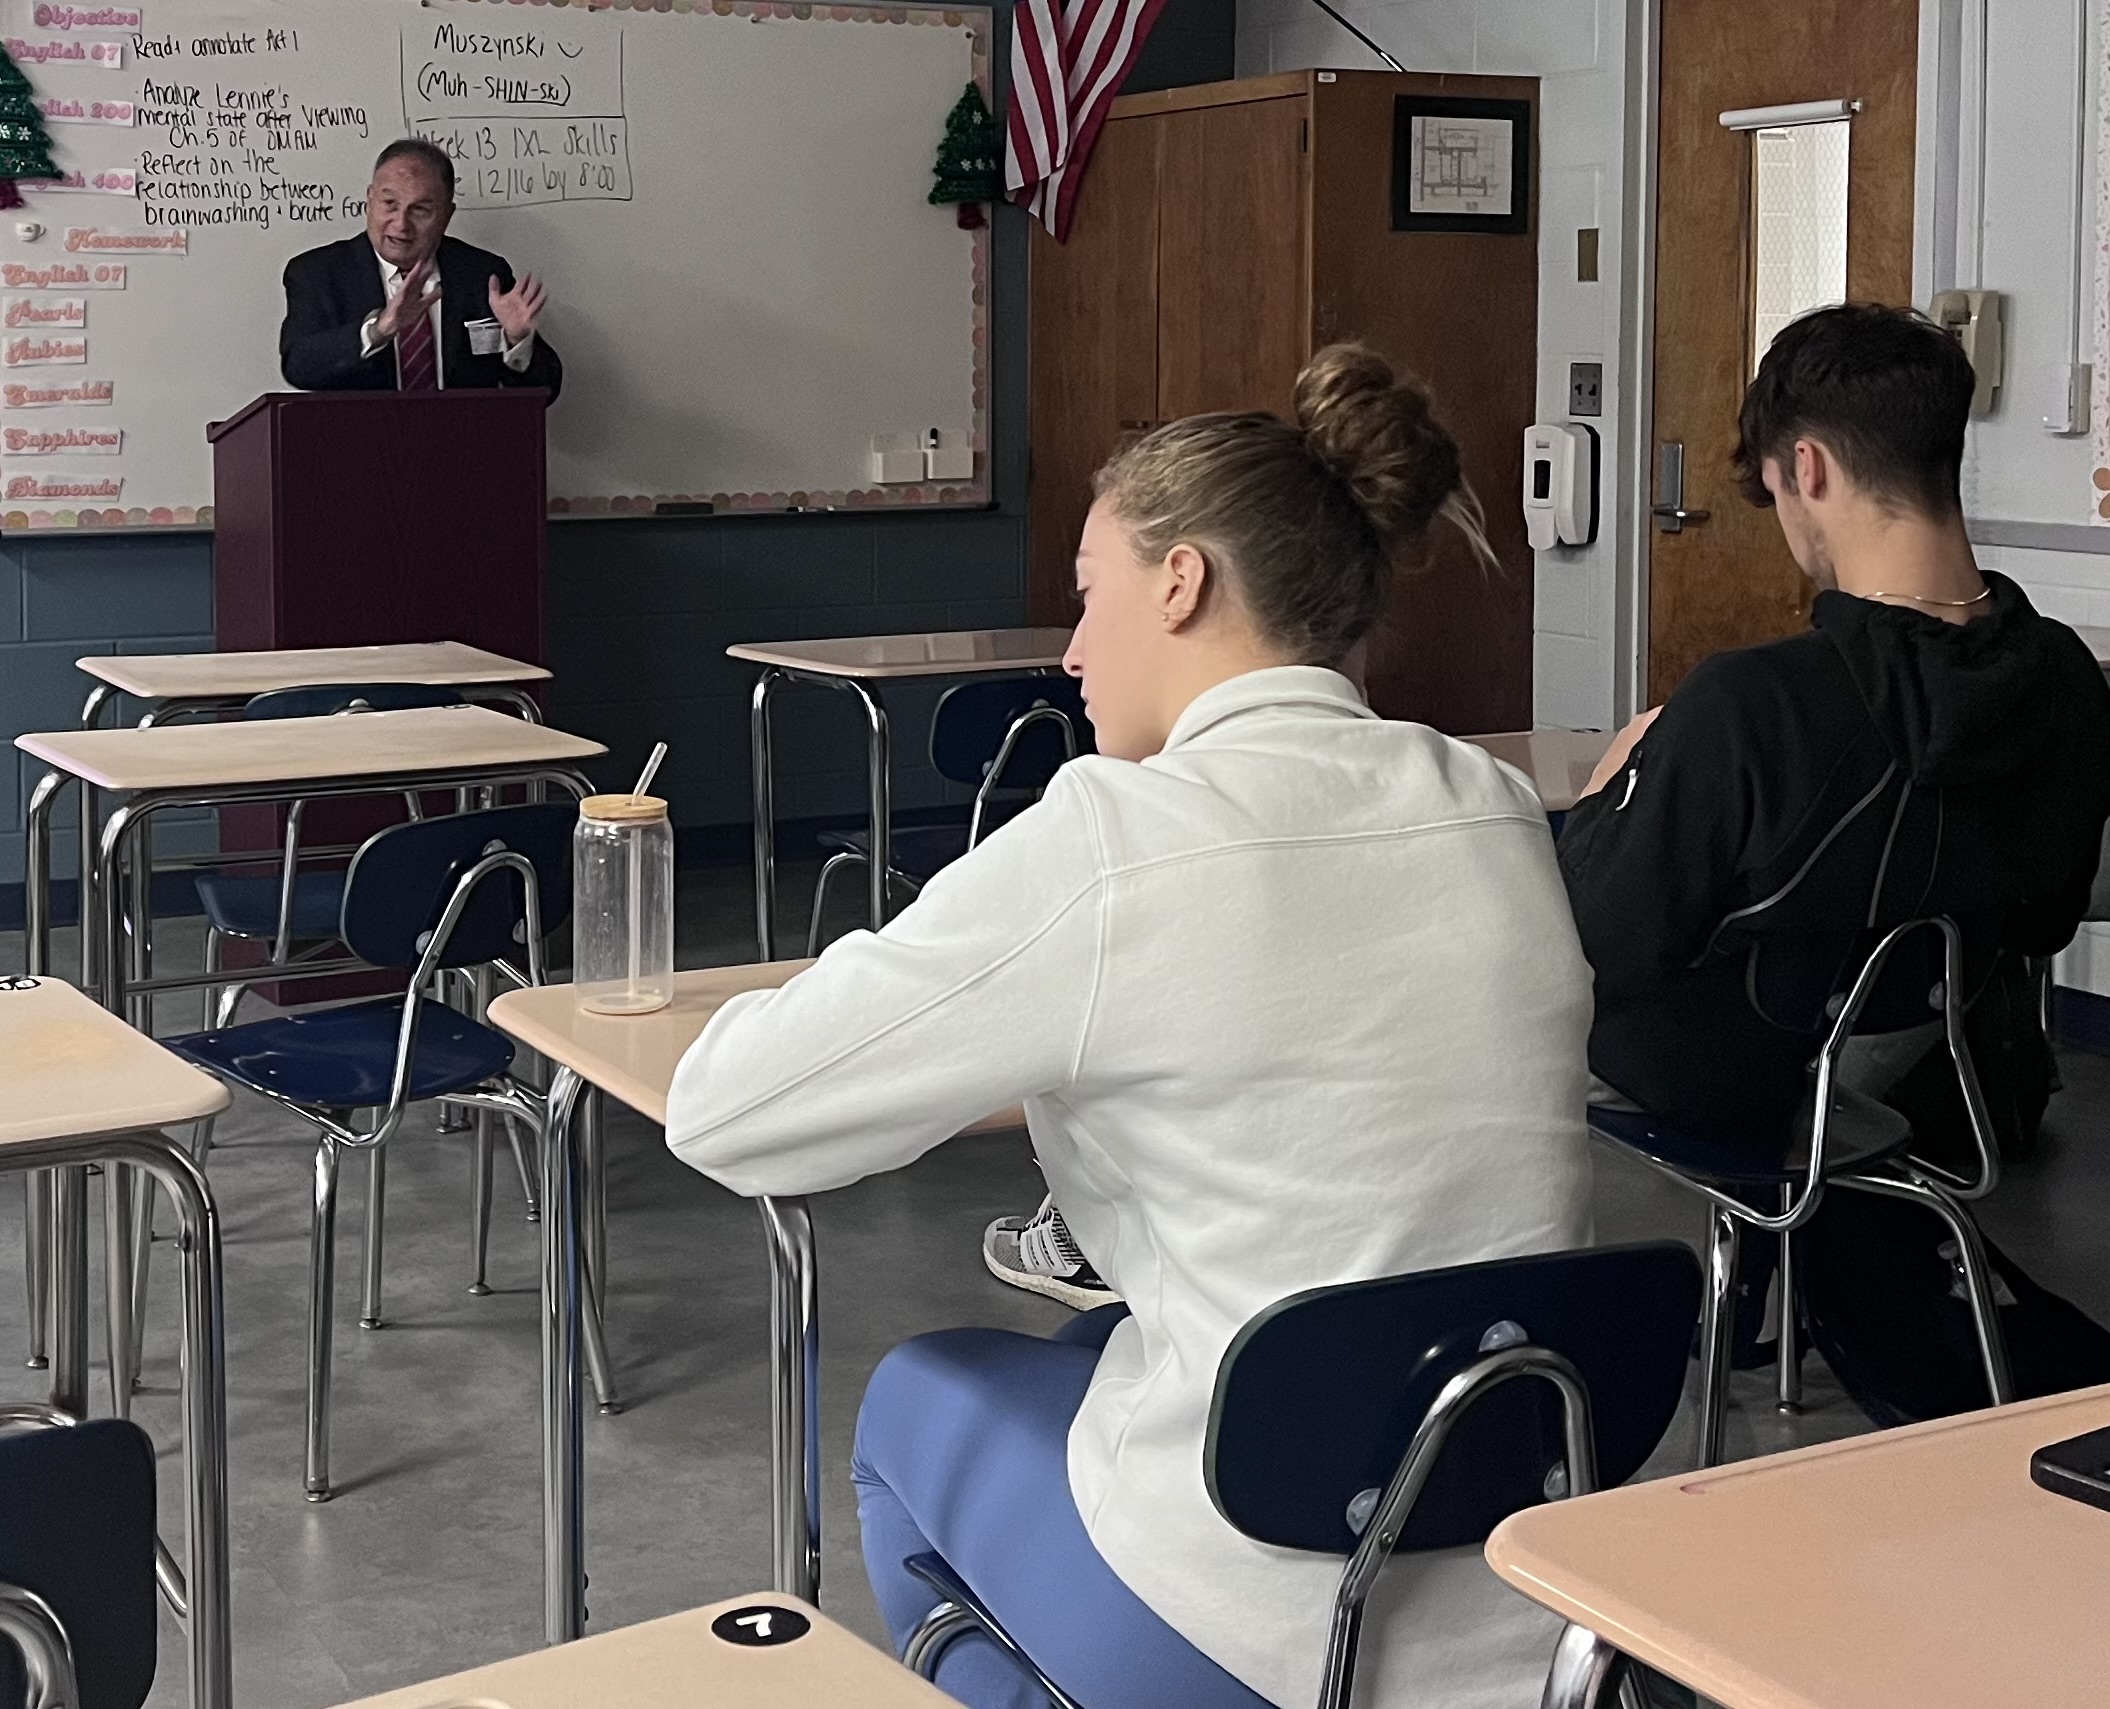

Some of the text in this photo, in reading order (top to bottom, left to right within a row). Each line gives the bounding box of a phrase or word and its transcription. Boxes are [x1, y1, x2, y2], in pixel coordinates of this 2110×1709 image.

[34, 3, 139, 30] Objective
[4, 38, 119, 63] English 07
[191, 31, 256, 57] annotate
[434, 23, 544, 61] Muszynski
[41, 98, 132, 120] lish 200
[215, 82, 290, 111] Lennie's
[206, 108, 247, 128] state
[255, 108, 292, 130] after
[475, 126, 497, 161] 13
[513, 127, 552, 159] IXL
[210, 157, 235, 176] on
[241, 147, 280, 176] the
[91, 173, 135, 191] 400
[135, 176, 335, 208] relationship between
[477, 167, 534, 202] 12/16
[541, 161, 567, 201] by
[144, 201, 270, 230] brainwashing
[289, 199, 334, 223] brute
[65, 229, 187, 252] Homework
[2, 263, 122, 288] English 07
[5, 299, 84, 328] Pearls
[3, 381, 113, 406] Emeralds
[4, 428, 119, 452] Sapphires
[5, 476, 119, 500] Diamonds
